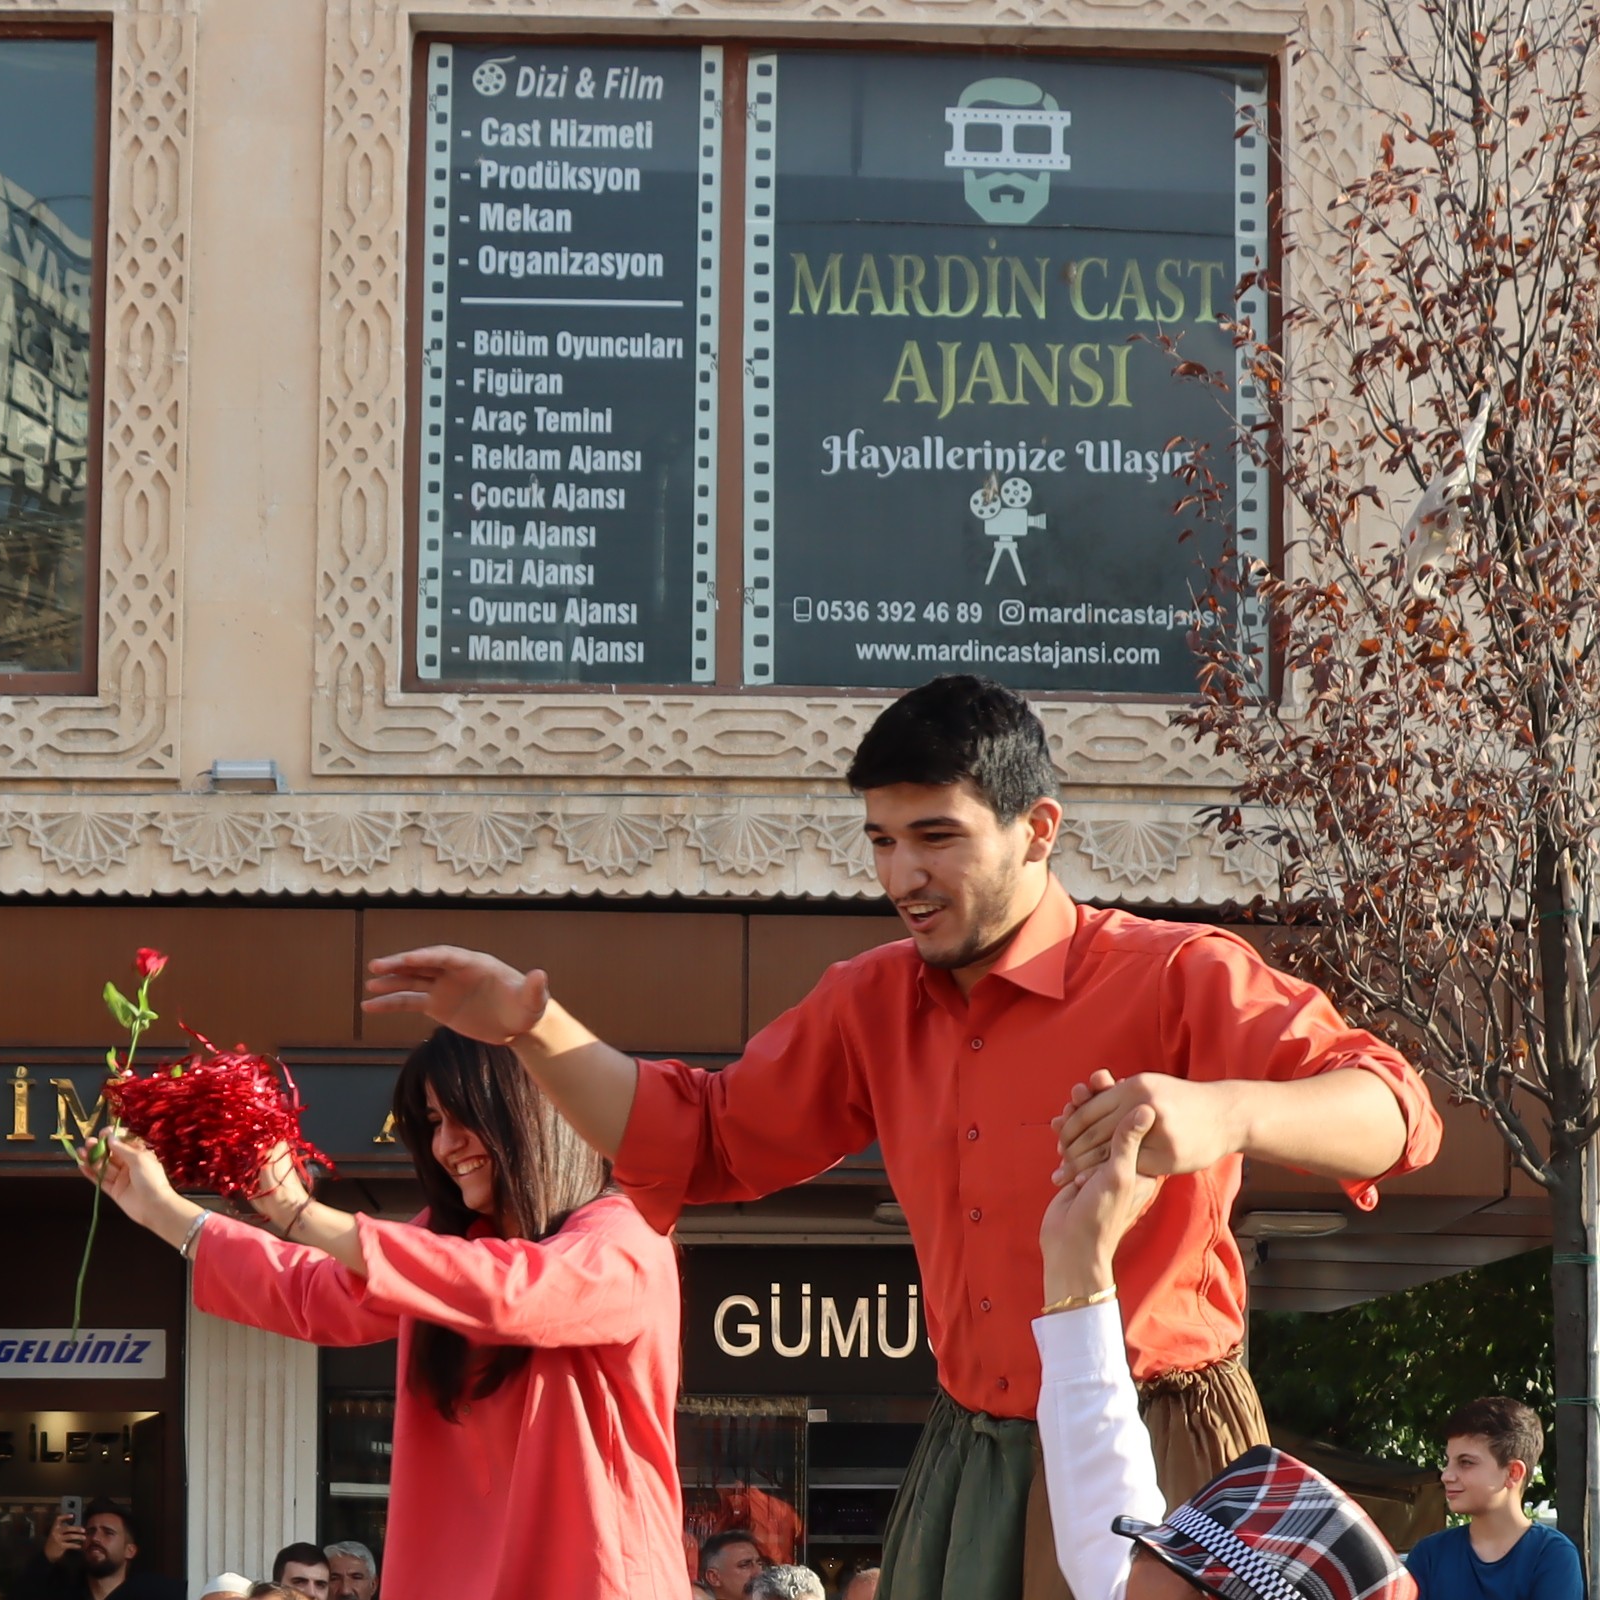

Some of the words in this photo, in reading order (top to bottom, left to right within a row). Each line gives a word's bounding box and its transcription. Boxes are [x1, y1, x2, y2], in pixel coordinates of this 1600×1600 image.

[515, 65, 567, 98] Dizi
[574, 69, 595, 98] &
[603, 67, 664, 99] Film
[480, 118, 541, 148] Cast
[550, 119, 653, 149] Hizmeti
[479, 160, 641, 194] Prodüksyon
[479, 203, 572, 232] Mekan
[478, 245, 664, 280] Organizasyon
[789, 238, 1050, 319] MARDİN
[1070, 256, 1225, 323] CAST
[473, 329, 549, 358] Bölüm
[556, 330, 684, 360] Oyuncuları
[473, 368, 563, 396] Figüran
[884, 339, 1133, 420] AJANSI
[471, 406, 527, 436] Araç
[534, 407, 612, 434] Temini
[471, 444, 561, 471] Reklam
[568, 445, 641, 474] Ajansı
[821, 428, 1067, 478] Hayallerinize
[470, 482, 546, 511] Çocuk
[552, 483, 626, 511] Ajansı
[469, 520, 516, 549] Klip
[522, 521, 596, 550] Ajansı
[469, 558, 514, 585] Dizi
[520, 559, 594, 588] Ajansı
[468, 596, 557, 624] Oyuncu
[563, 597, 638, 626] Ajansı
[816, 600, 870, 622] 0536
[876, 601, 917, 622] 392
[922, 601, 950, 623] 46
[956, 602, 983, 623] 89
[468, 634, 564, 662] Manken
[570, 636, 645, 665] Ajansı
[855, 639, 1160, 668] www.mardincastajansi.com
[713, 1283, 935, 1359] GÜMÜ
